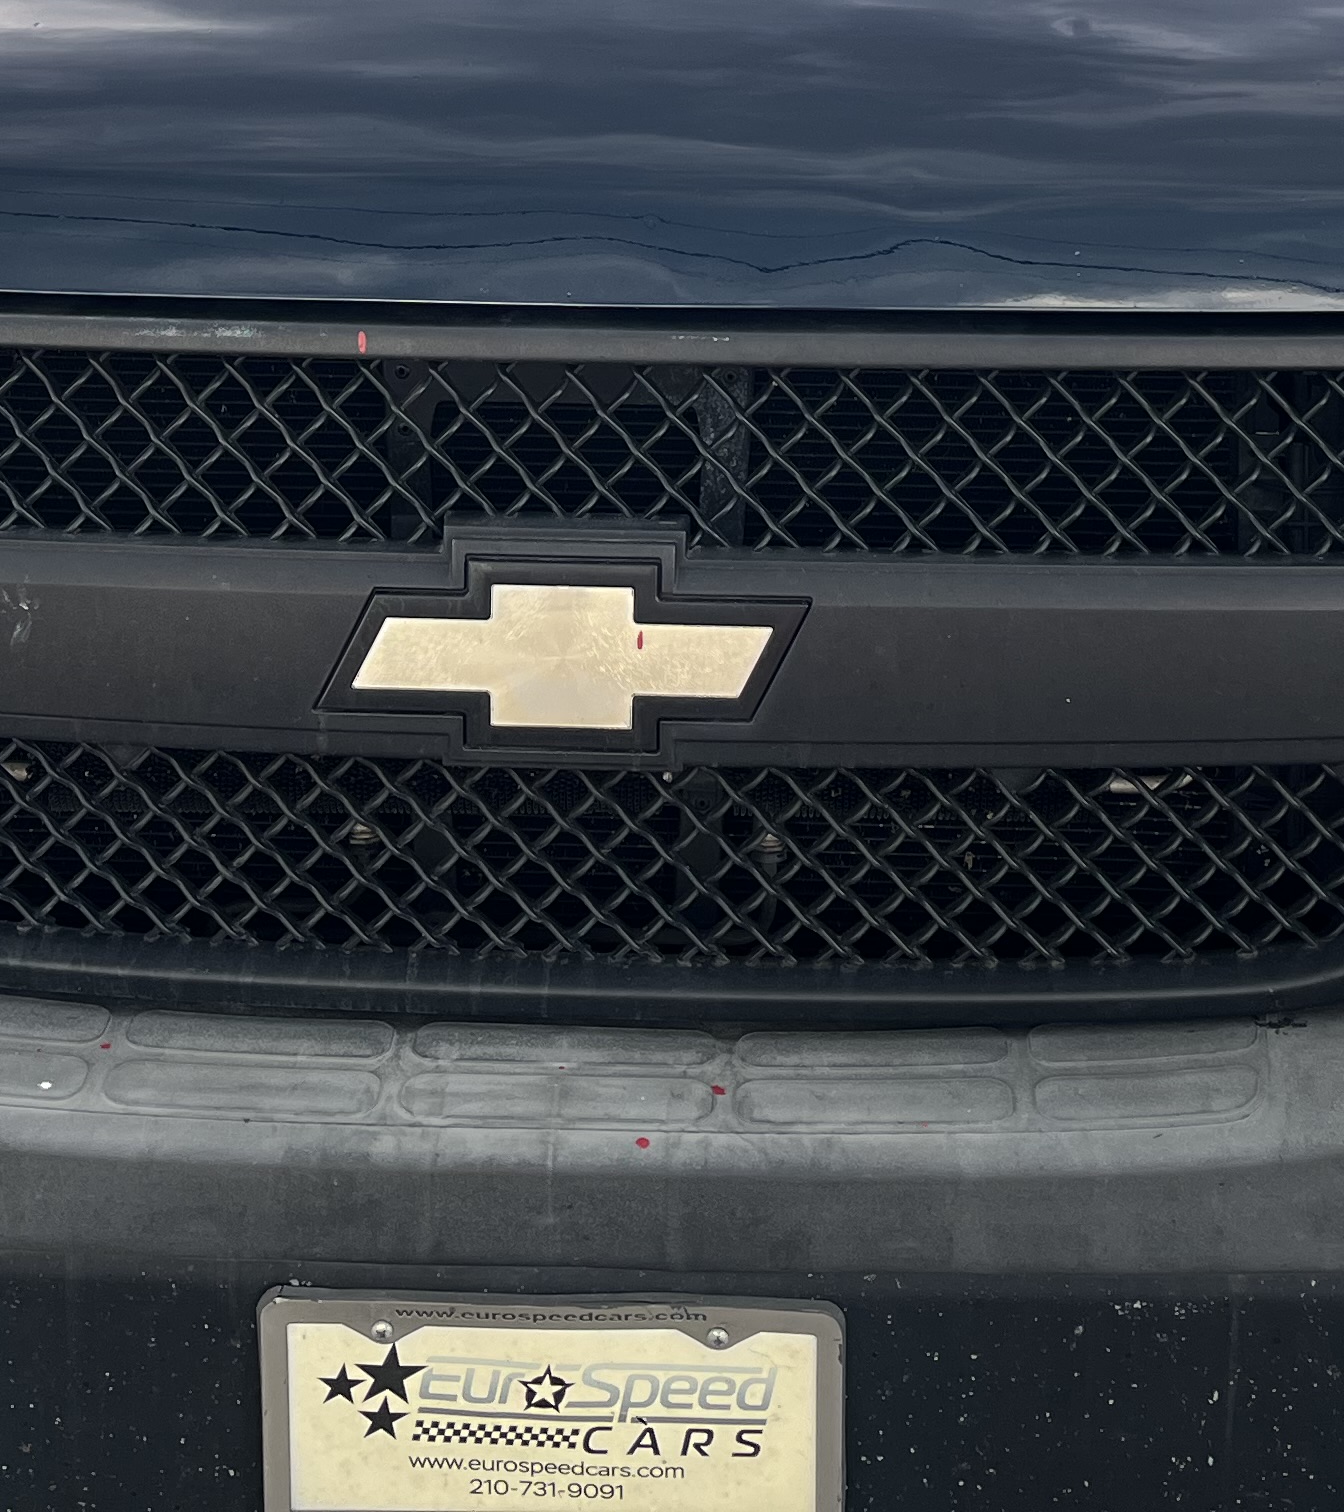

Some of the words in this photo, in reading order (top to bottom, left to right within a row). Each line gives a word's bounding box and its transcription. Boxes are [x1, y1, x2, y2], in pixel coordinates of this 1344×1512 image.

[395, 1306, 707, 1325] www.eurospeedcars.com
[583, 1426, 763, 1457] CARS
[408, 1454, 685, 1479] www.eurospeedcars.com
[469, 1478, 624, 1500] 210-731-9091
